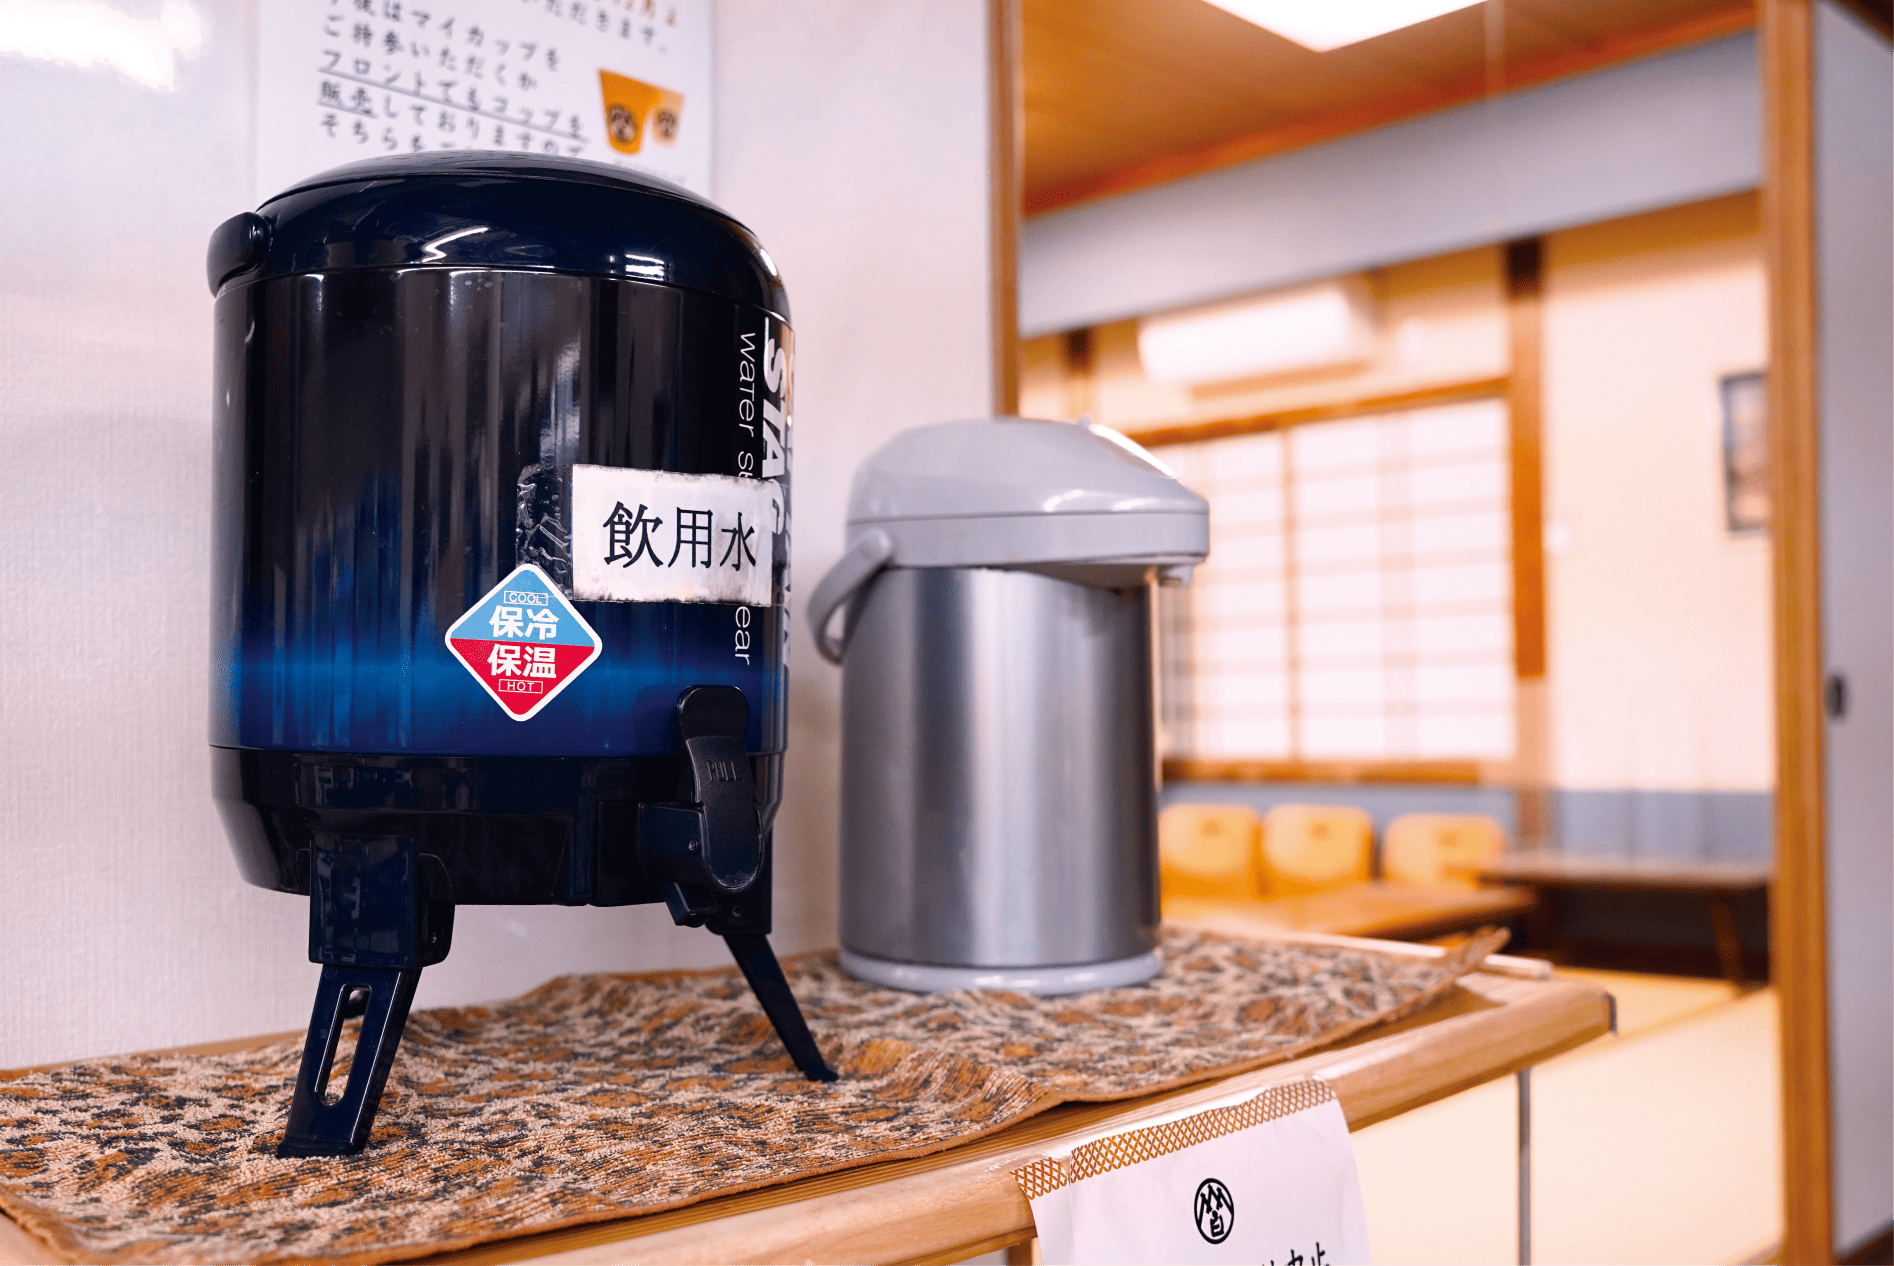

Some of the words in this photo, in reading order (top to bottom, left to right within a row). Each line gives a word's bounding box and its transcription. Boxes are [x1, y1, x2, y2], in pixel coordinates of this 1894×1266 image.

[330, 0, 562, 72] 後はマイカップを
[601, 500, 757, 573] 飲用水
[508, 591, 543, 605] COOL
[488, 604, 560, 641] 保冷
[486, 643, 557, 679] 保温
[506, 681, 535, 693] HOT
[705, 760, 742, 782] PULL
